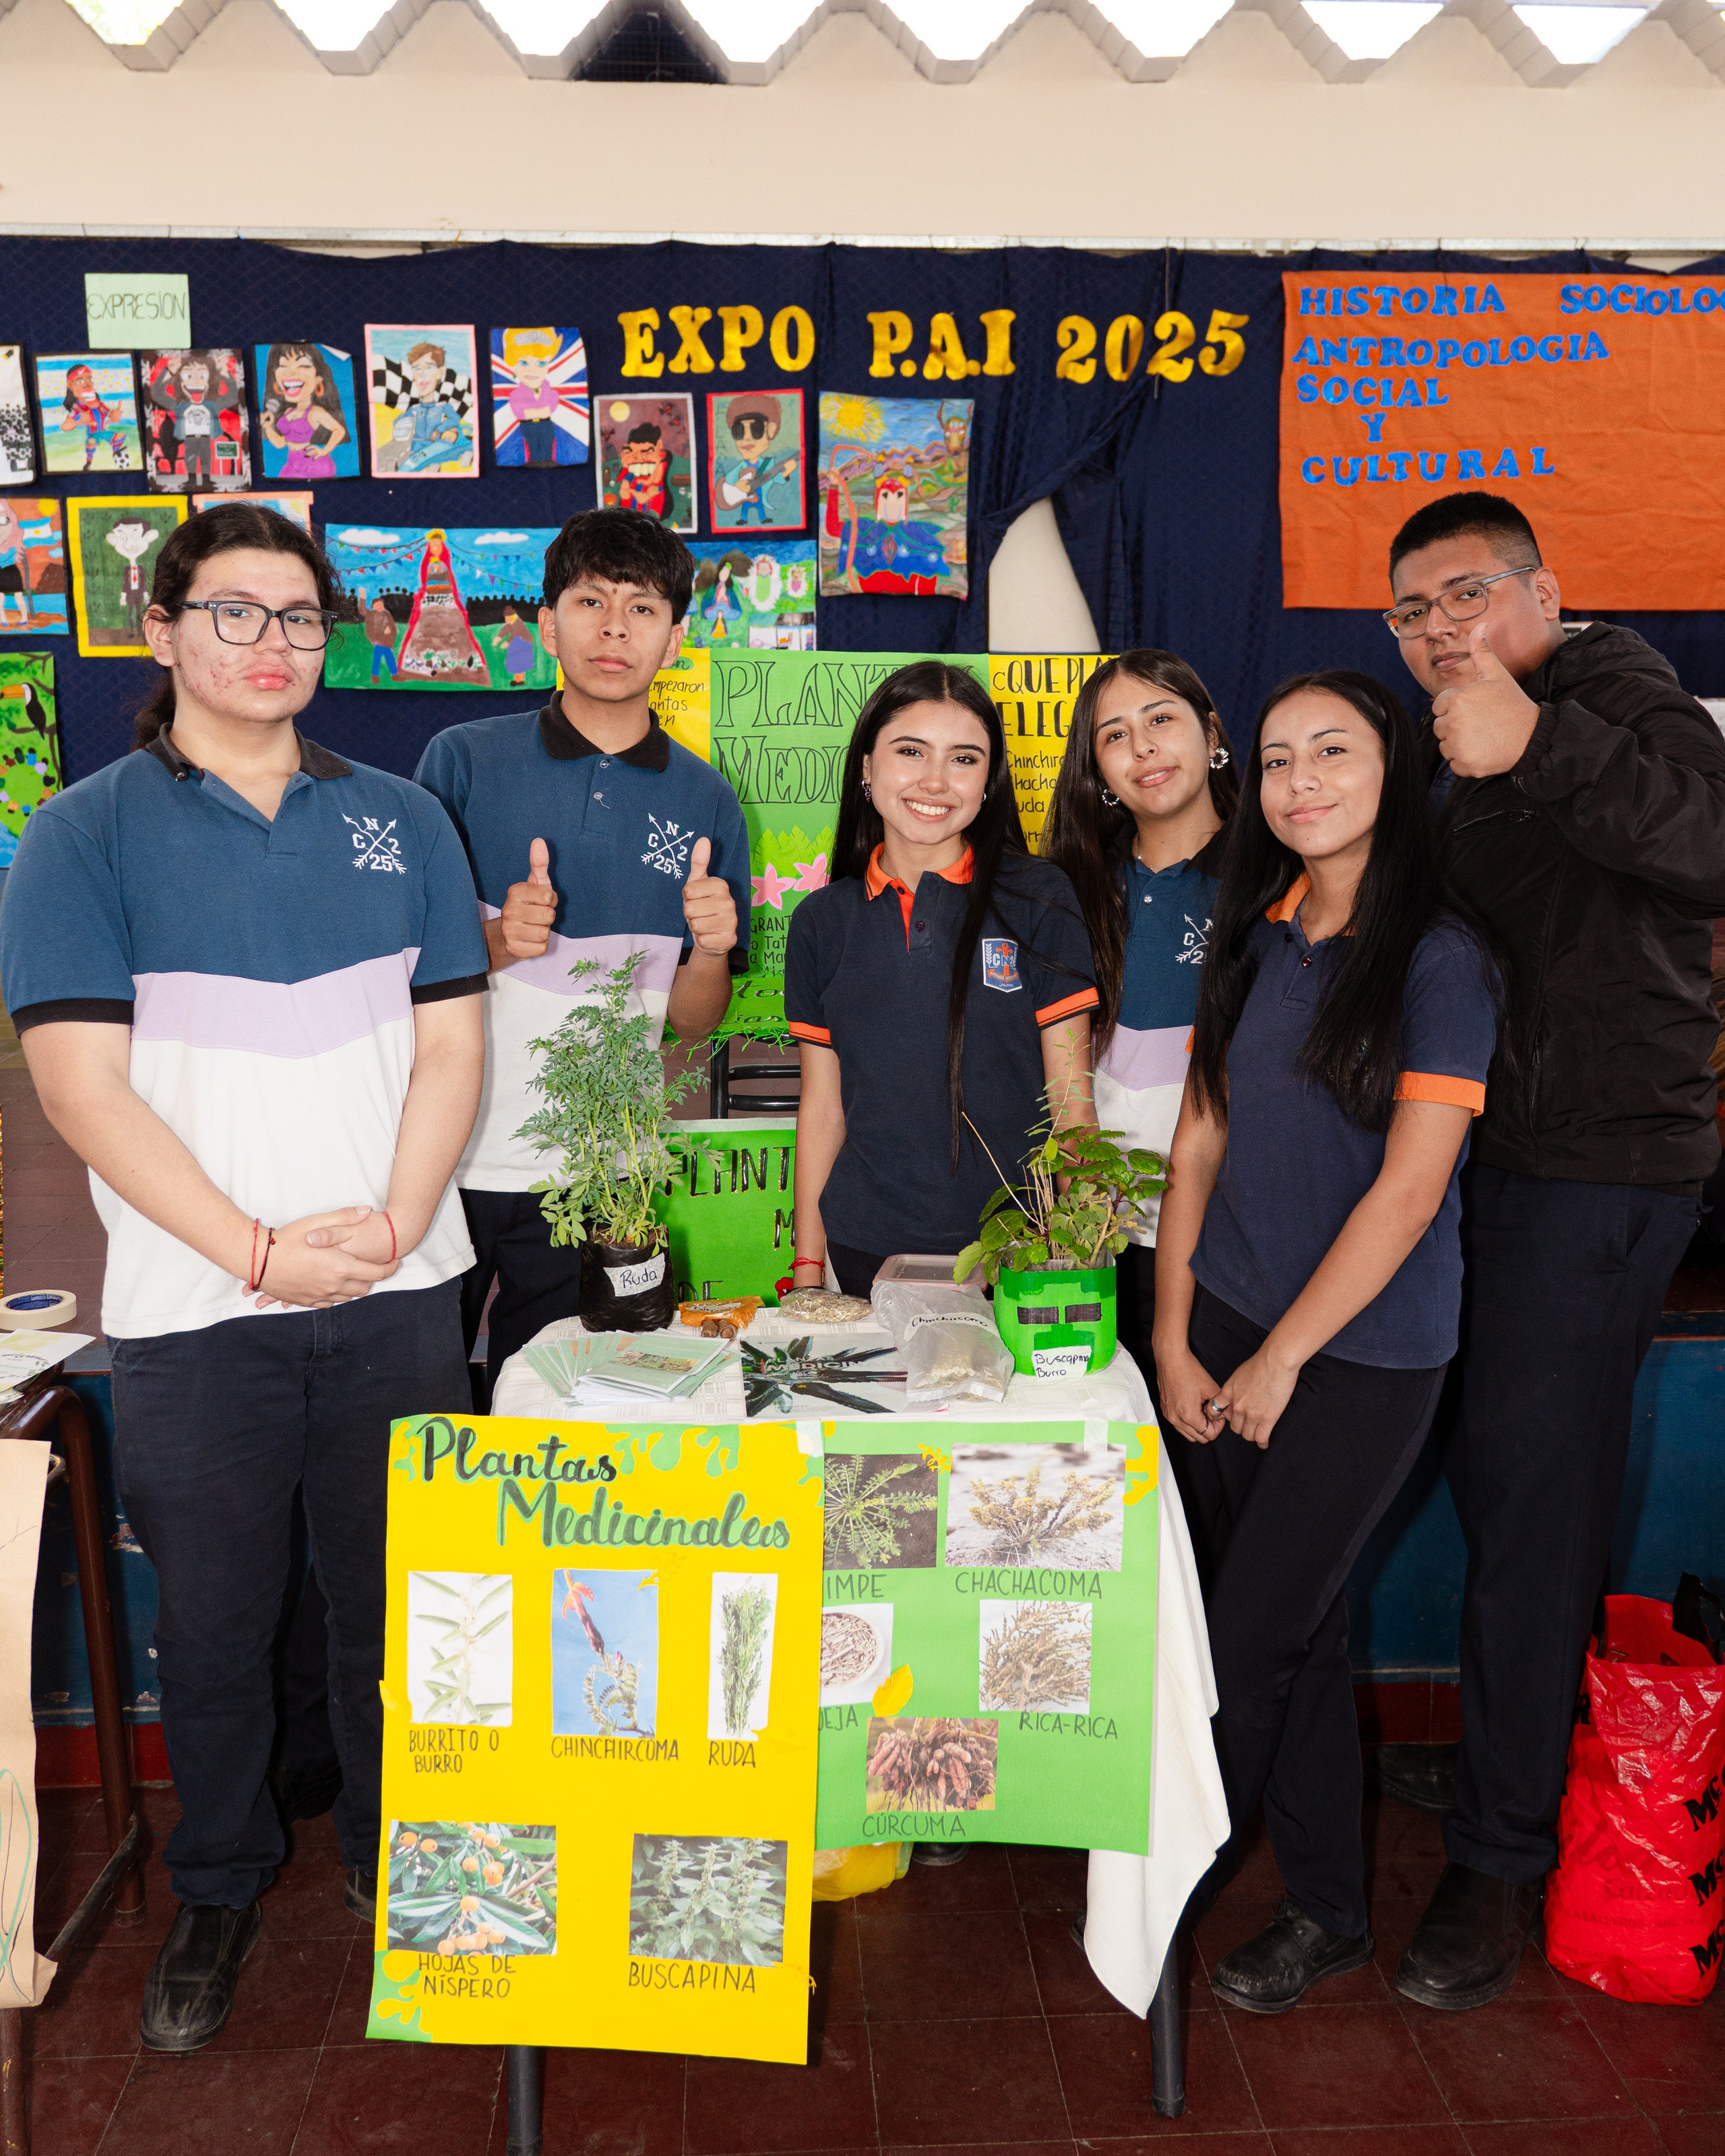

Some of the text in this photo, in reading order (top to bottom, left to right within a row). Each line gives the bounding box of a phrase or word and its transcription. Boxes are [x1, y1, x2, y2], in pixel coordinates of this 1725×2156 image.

[88, 292, 186, 320] EXPRESION
[1299, 284, 1505, 317] HISTORIA
[617, 305, 1250, 385] EXPO P.A.I 2025
[1291, 331, 1610, 369] ANTROPOLOGIA
[1296, 375, 1449, 408] SOCIAL
[1359, 413, 1387, 443] Y
[1301, 447, 1555, 486] CULTURAL
[648, 695, 687, 711] antas
[713, 736, 844, 804] MEDI
[1018, 797, 1044, 813] uda
[363, 817, 379, 831] N
[665, 820, 680, 836] N
[352, 833, 402, 854] C 2
[648, 833, 688, 862] C 2
[369, 854, 393, 872] 25
[653, 854, 675, 875] 25
[764, 935, 788, 951] Tat
[1183, 932, 1195, 946] C
[1190, 951, 1208, 964] 2
[664, 1146, 796, 1199] PLANT
[620, 1267, 658, 1289] Ruda
[1036, 1367, 1067, 1378] Burro
[415, 1417, 617, 1482] Plantas
[497, 1478, 790, 1550] Medicinales
[826, 1570, 1102, 1599] IMPE CHACHACOMA
[1020, 1711, 1119, 1740] RICA-RICA
[408, 1728, 500, 1753] BURRITO O
[551, 1736, 681, 1763] CHINCHIRCOMA
[414, 1754, 464, 1774] BURRO
[708, 1741, 757, 1769] RUDA
[862, 1812, 966, 1838] CÚRCUMA
[418, 1953, 516, 1976] HOJAS DE
[629, 1961, 756, 1994] BUSCAPINA
[422, 1975, 511, 1999] NÍSPERO
